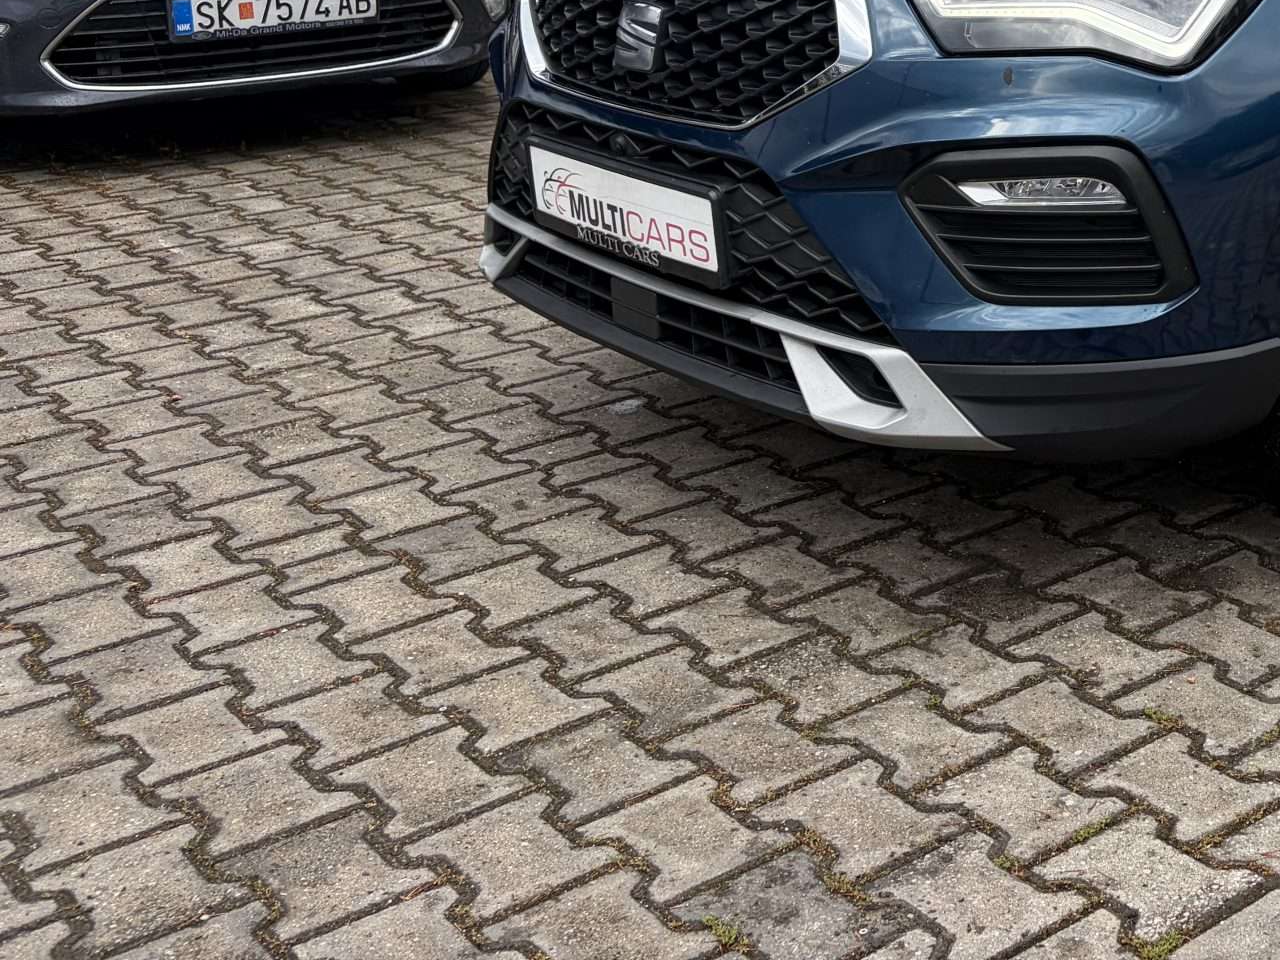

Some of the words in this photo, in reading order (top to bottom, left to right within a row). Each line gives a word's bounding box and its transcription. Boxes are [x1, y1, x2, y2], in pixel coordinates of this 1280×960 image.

[196, 0, 235, 30] SK
[250, 23, 283, 35] Grand
[285, 21, 321, 32] Motors
[568, 189, 711, 263] MULTICARS
[576, 225, 620, 253] MULTI
[622, 243, 660, 267] CARS
